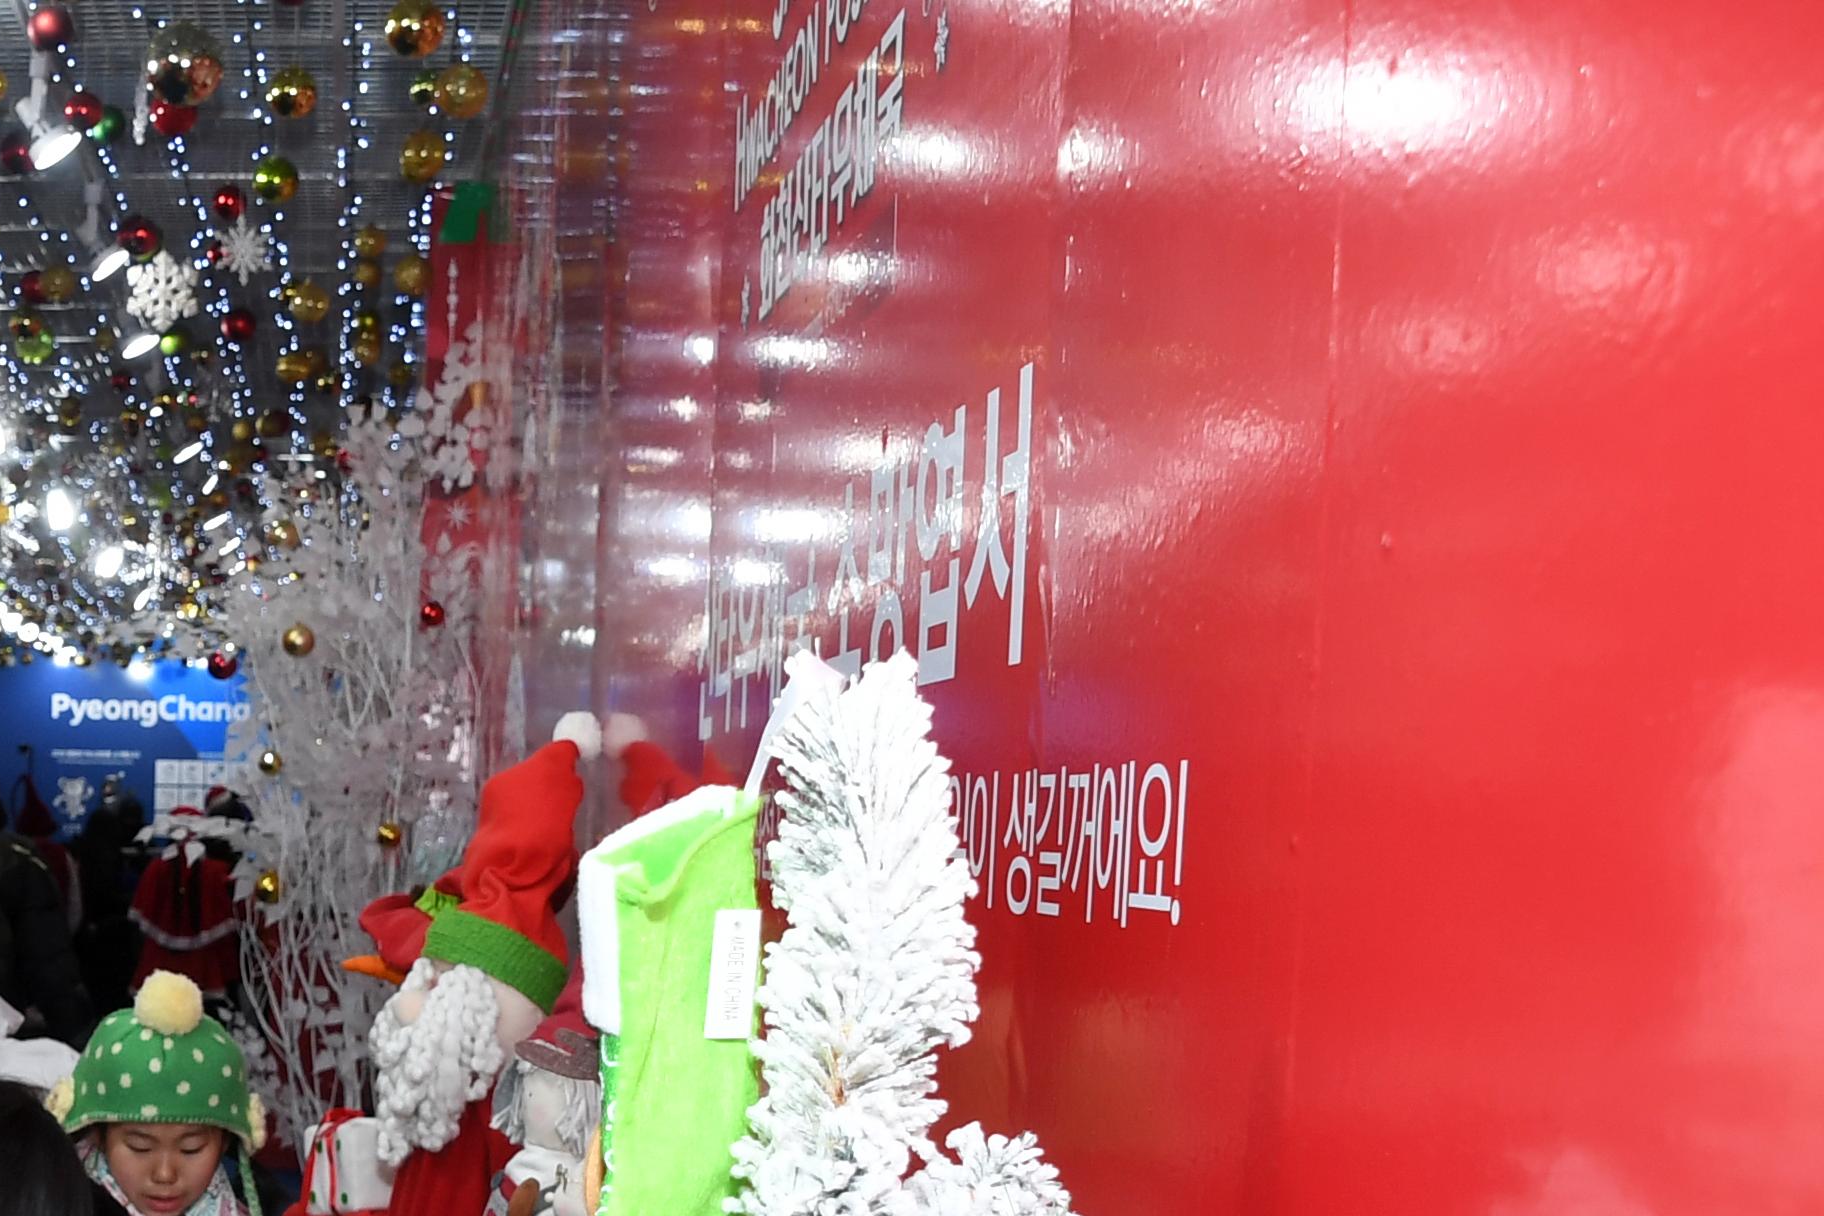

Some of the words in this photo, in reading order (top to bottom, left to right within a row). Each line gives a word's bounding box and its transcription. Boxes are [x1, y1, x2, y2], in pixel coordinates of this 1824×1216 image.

[758, 8, 906, 321] 화천산타우체국
[826, 361, 1034, 687] 소망엽서
[1003, 759, 1189, 929] 생길꺼에요!
